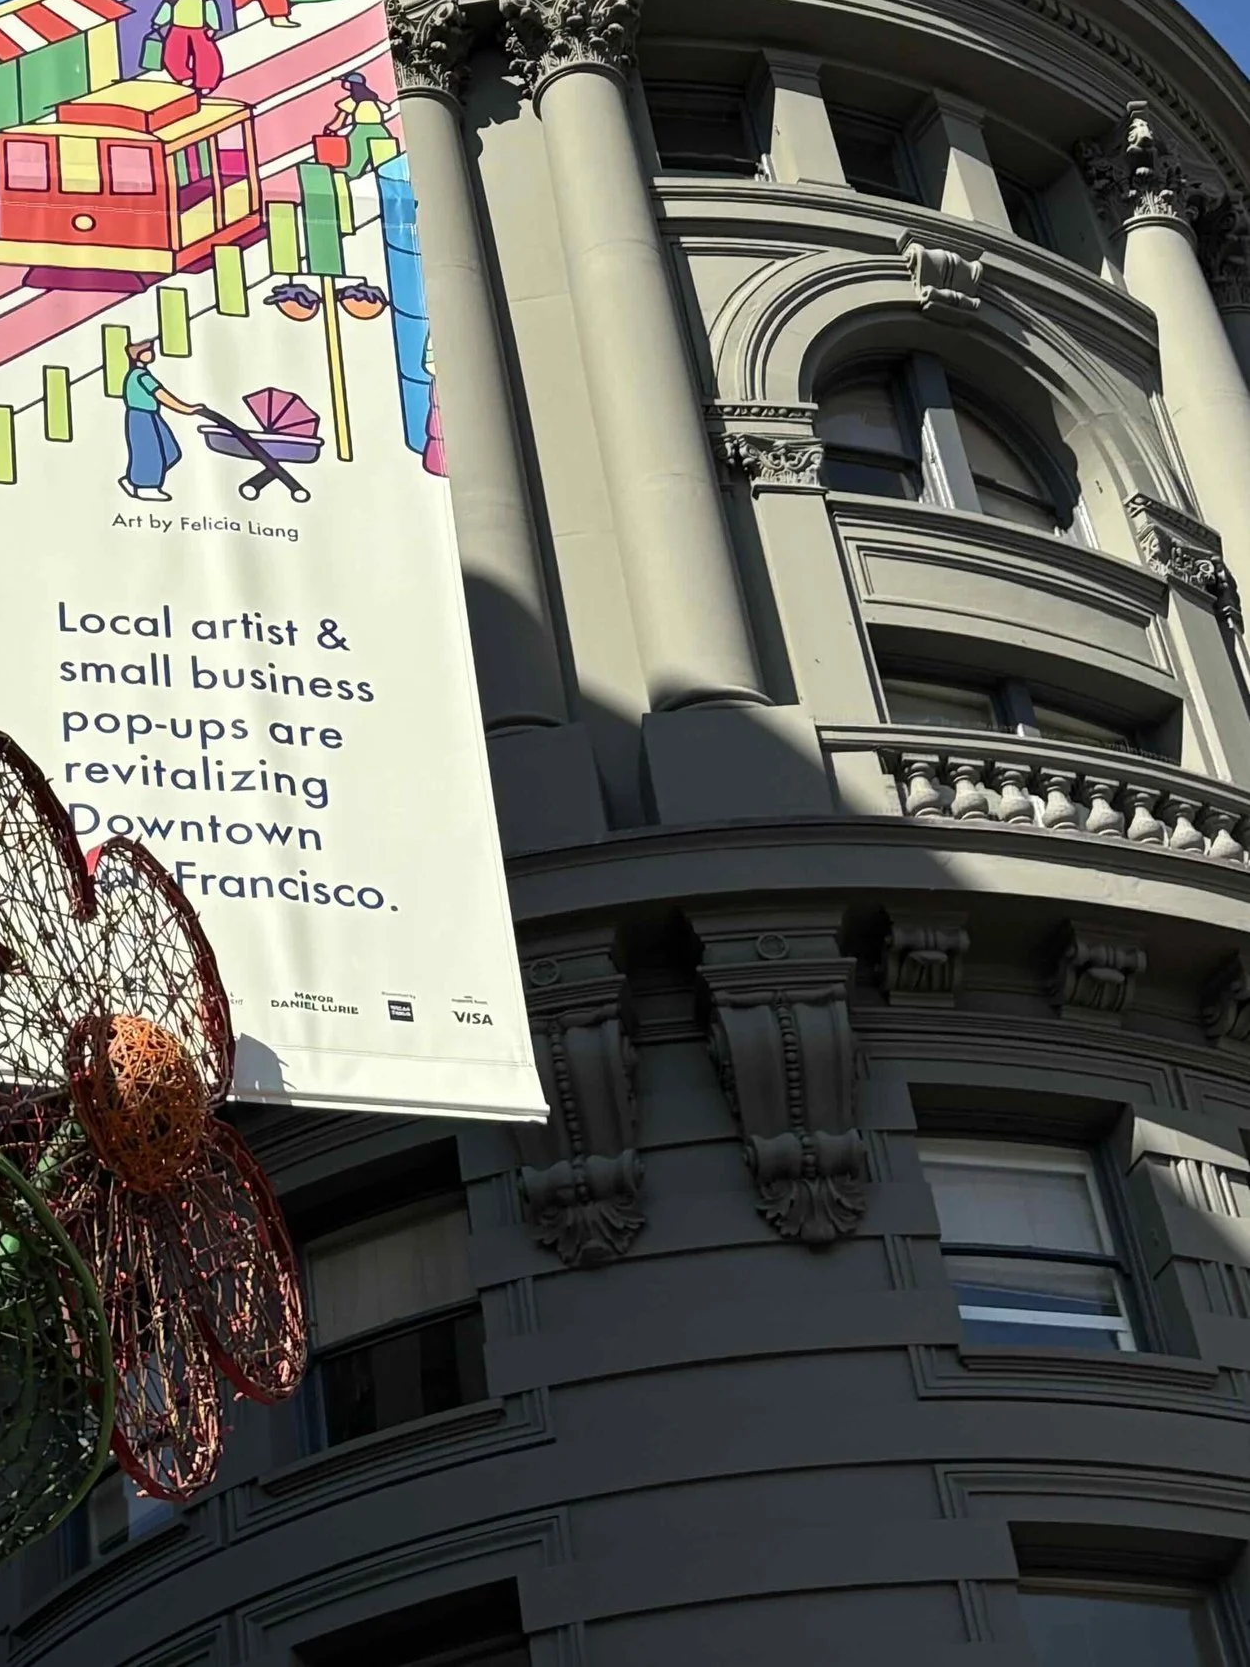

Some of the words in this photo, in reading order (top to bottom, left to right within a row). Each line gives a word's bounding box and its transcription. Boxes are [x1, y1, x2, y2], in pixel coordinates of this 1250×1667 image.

[111, 512, 143, 528] Art
[149, 513, 173, 533] by
[180, 515, 241, 532] Felicia
[247, 520, 299, 542] Liang
[58, 601, 172, 638] Local
[191, 611, 299, 647] artist
[316, 618, 351, 652] &
[59, 652, 172, 688] small
[190, 655, 375, 703] business
[62, 711, 249, 750] pop-ups
[268, 722, 343, 750] are
[65, 754, 329, 810] revitalizing
[68, 803, 322, 851] Downtown
[175, 860, 400, 913] Francisco.
[270, 999, 320, 1012] DANIEL
[321, 1003, 359, 1015] LURIE
[294, 991, 334, 1004] MAYOR
[452, 1010, 494, 1026] VISA
